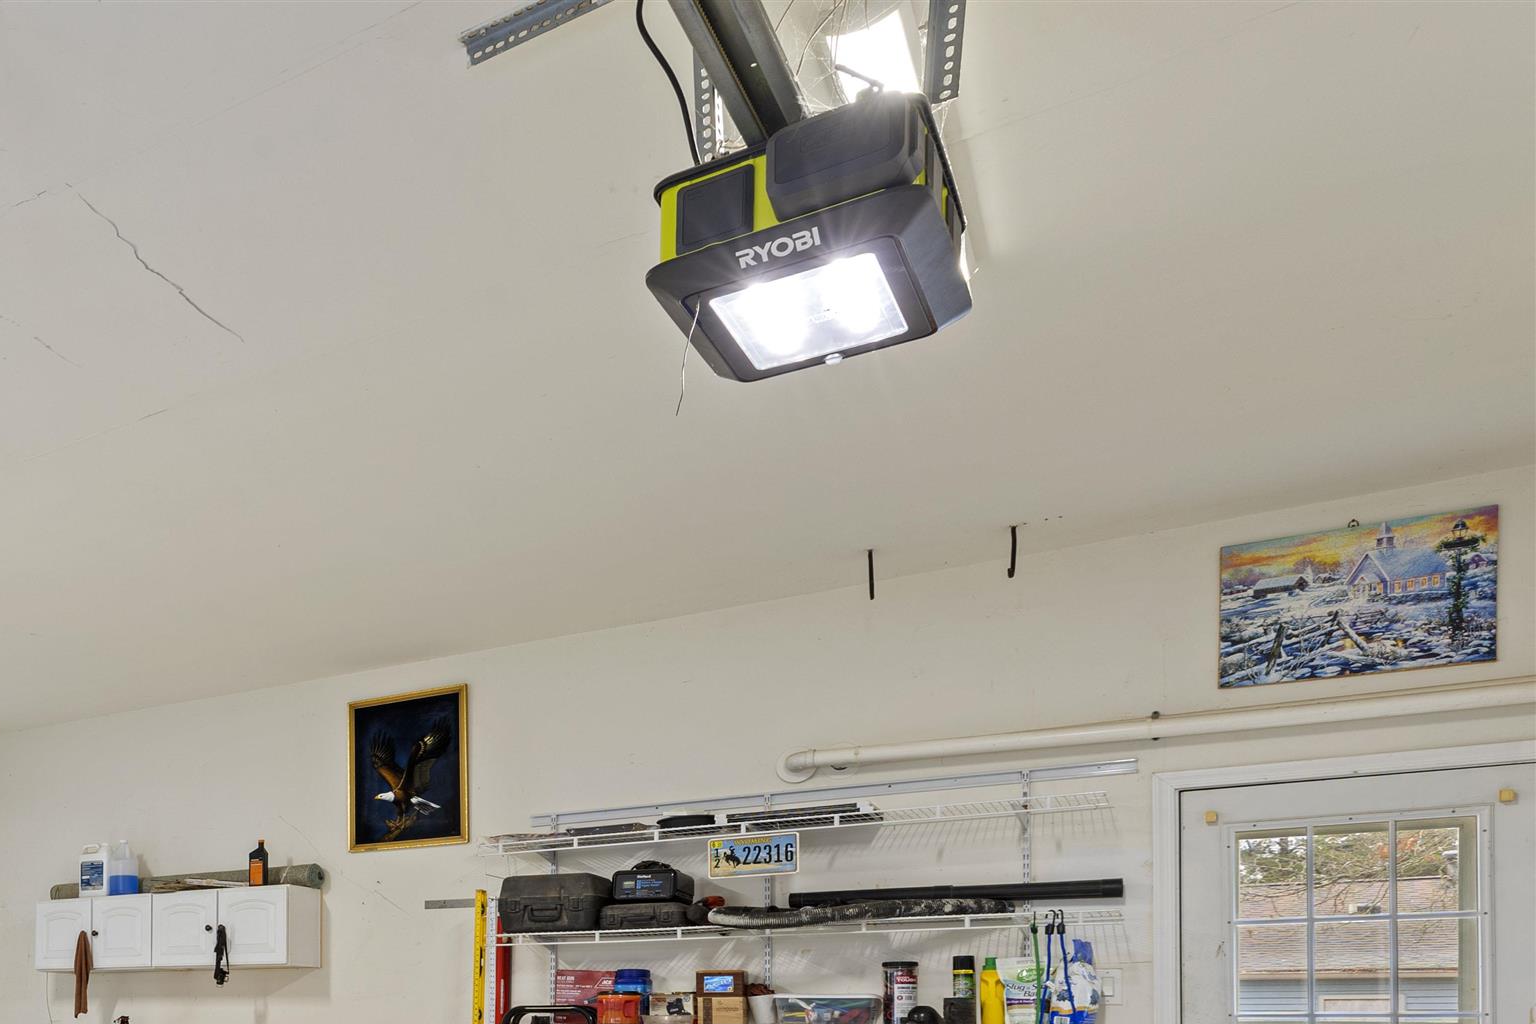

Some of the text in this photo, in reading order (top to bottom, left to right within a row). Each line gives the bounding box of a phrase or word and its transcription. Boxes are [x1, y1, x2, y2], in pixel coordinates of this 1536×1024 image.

[735, 226, 821, 269] RYOBI
[743, 843, 794, 866] 22316
[1007, 983, 1025, 992] Slug
